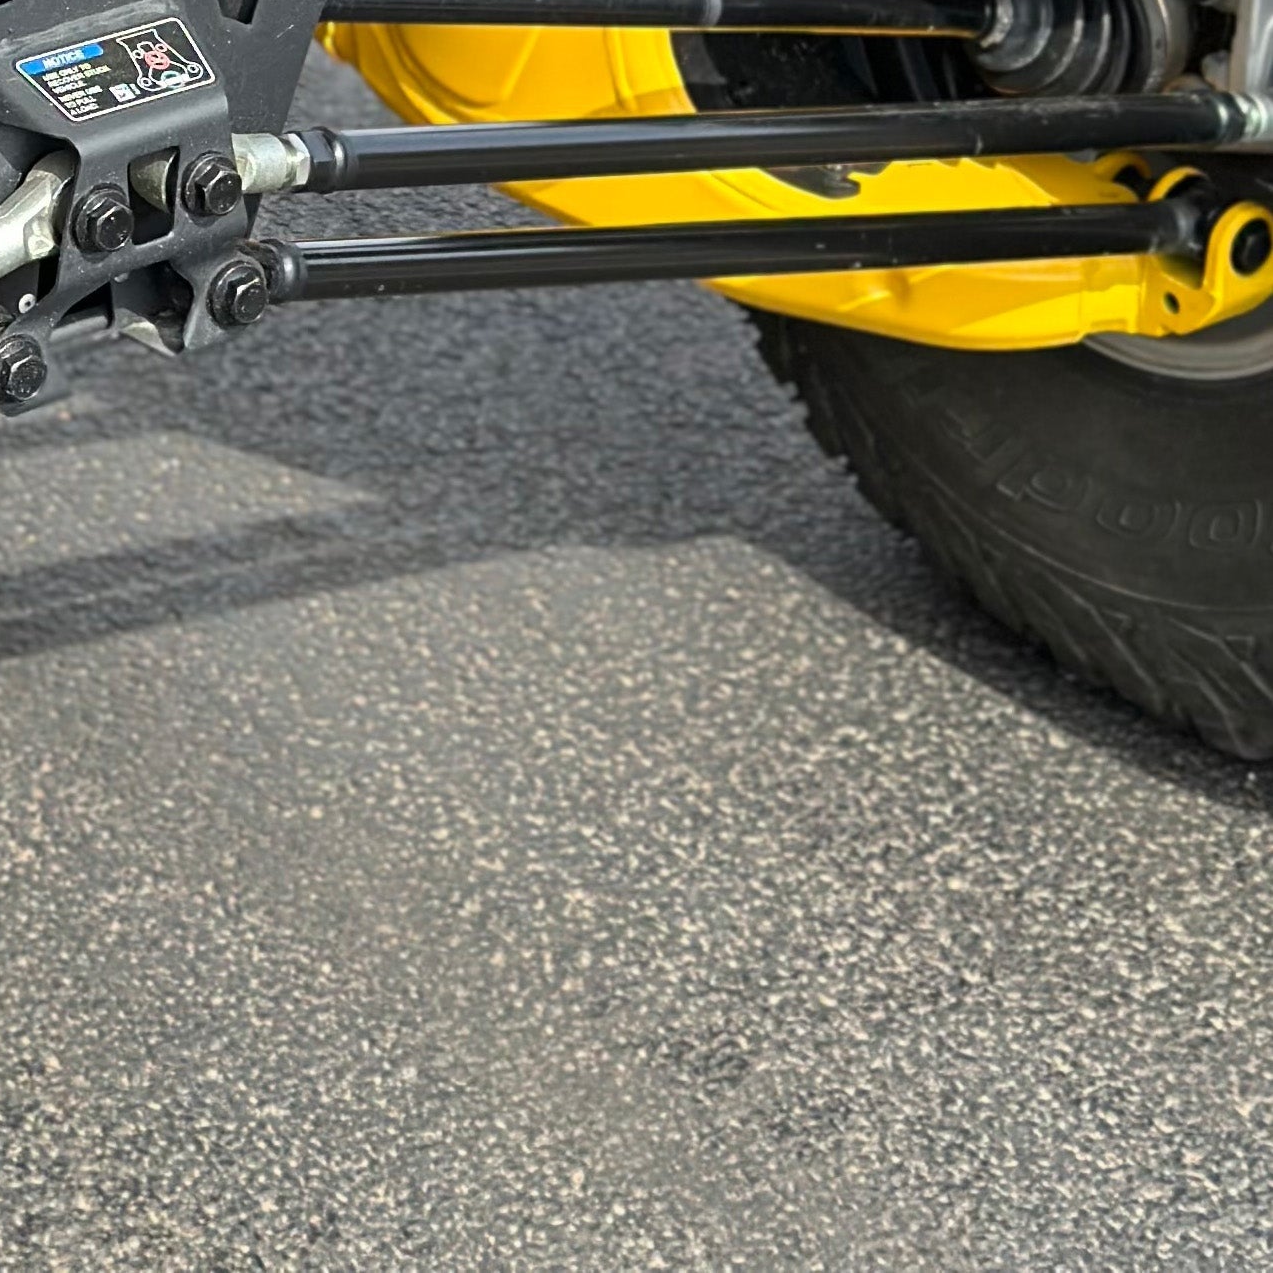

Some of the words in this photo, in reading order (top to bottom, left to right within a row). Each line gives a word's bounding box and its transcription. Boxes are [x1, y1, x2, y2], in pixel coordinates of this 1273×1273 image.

[42, 50, 85, 68] NOTICE
[47, 72, 85, 87] RECOVER
[83, 65, 112, 77] STUCK
[59, 66, 79, 76] ONLY
[79, 63, 91, 71] TO
[58, 91, 87, 102] NEVER
